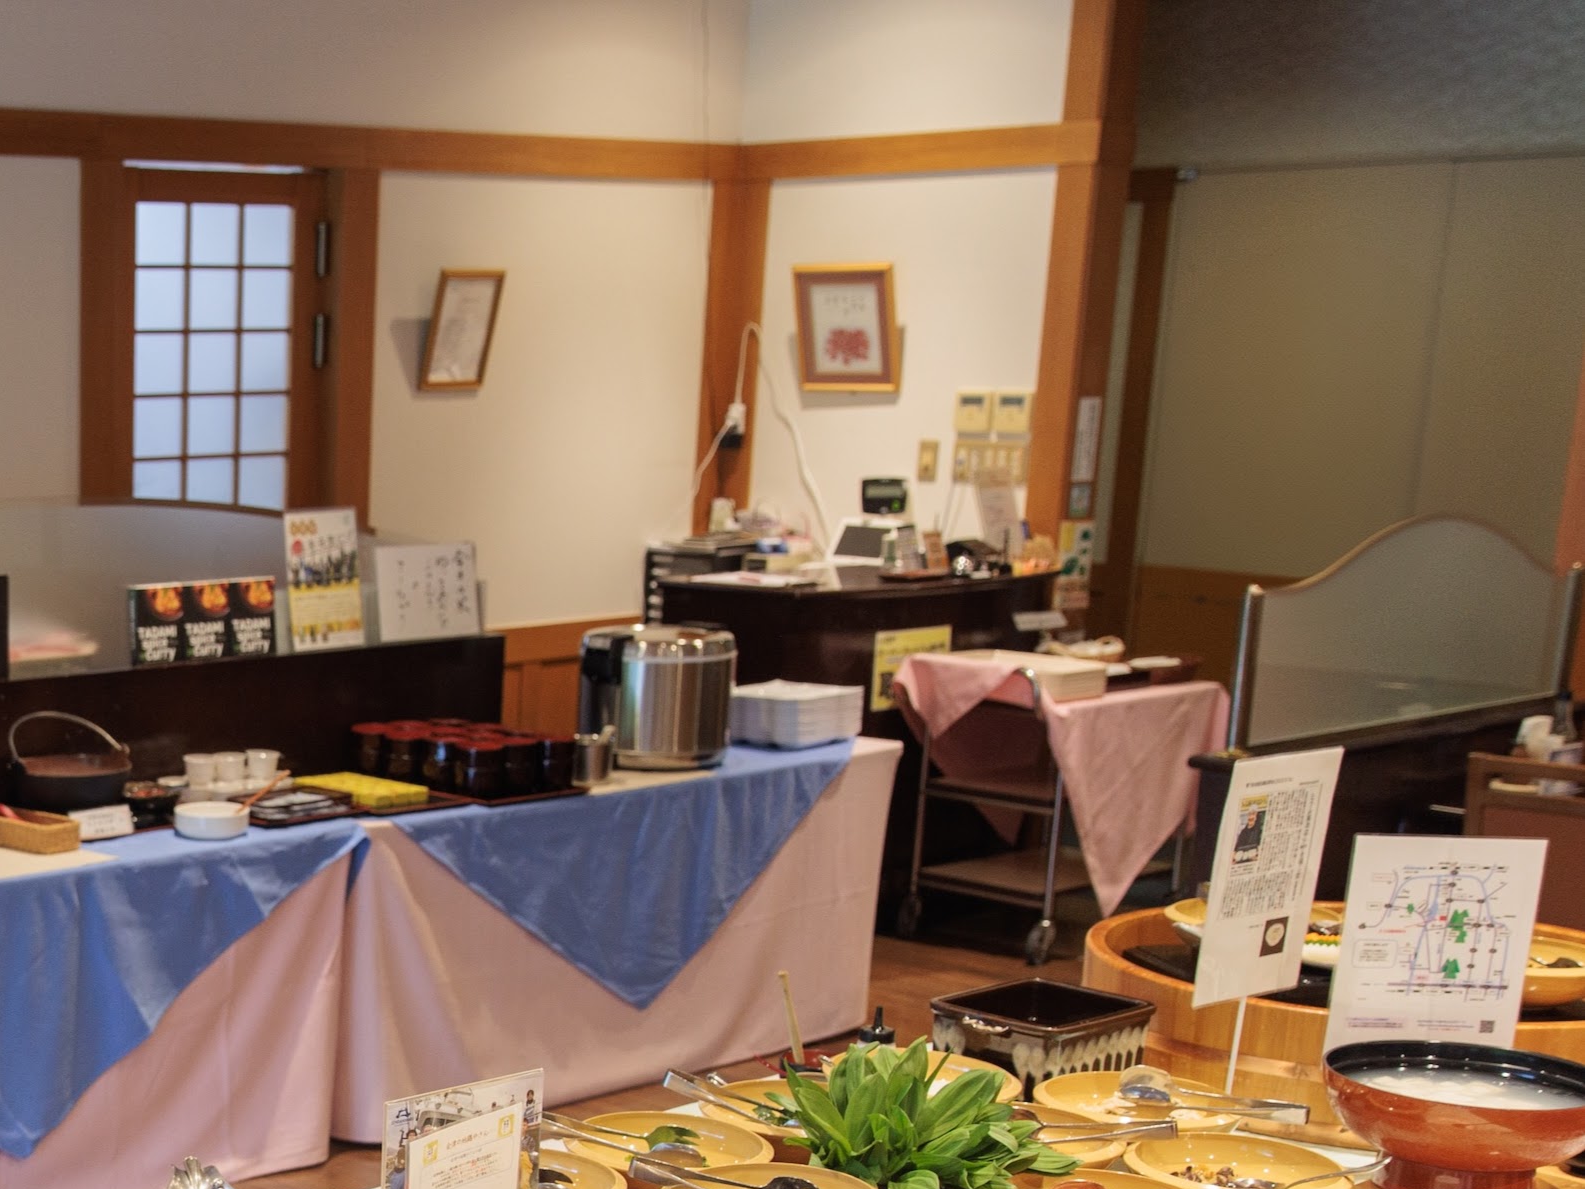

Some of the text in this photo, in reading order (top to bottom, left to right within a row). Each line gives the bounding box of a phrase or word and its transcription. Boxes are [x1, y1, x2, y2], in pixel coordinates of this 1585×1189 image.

[183, 620, 226, 636] TADAMI
[231, 616, 272, 631] TADAMI
[137, 624, 178, 640] TADAMI
